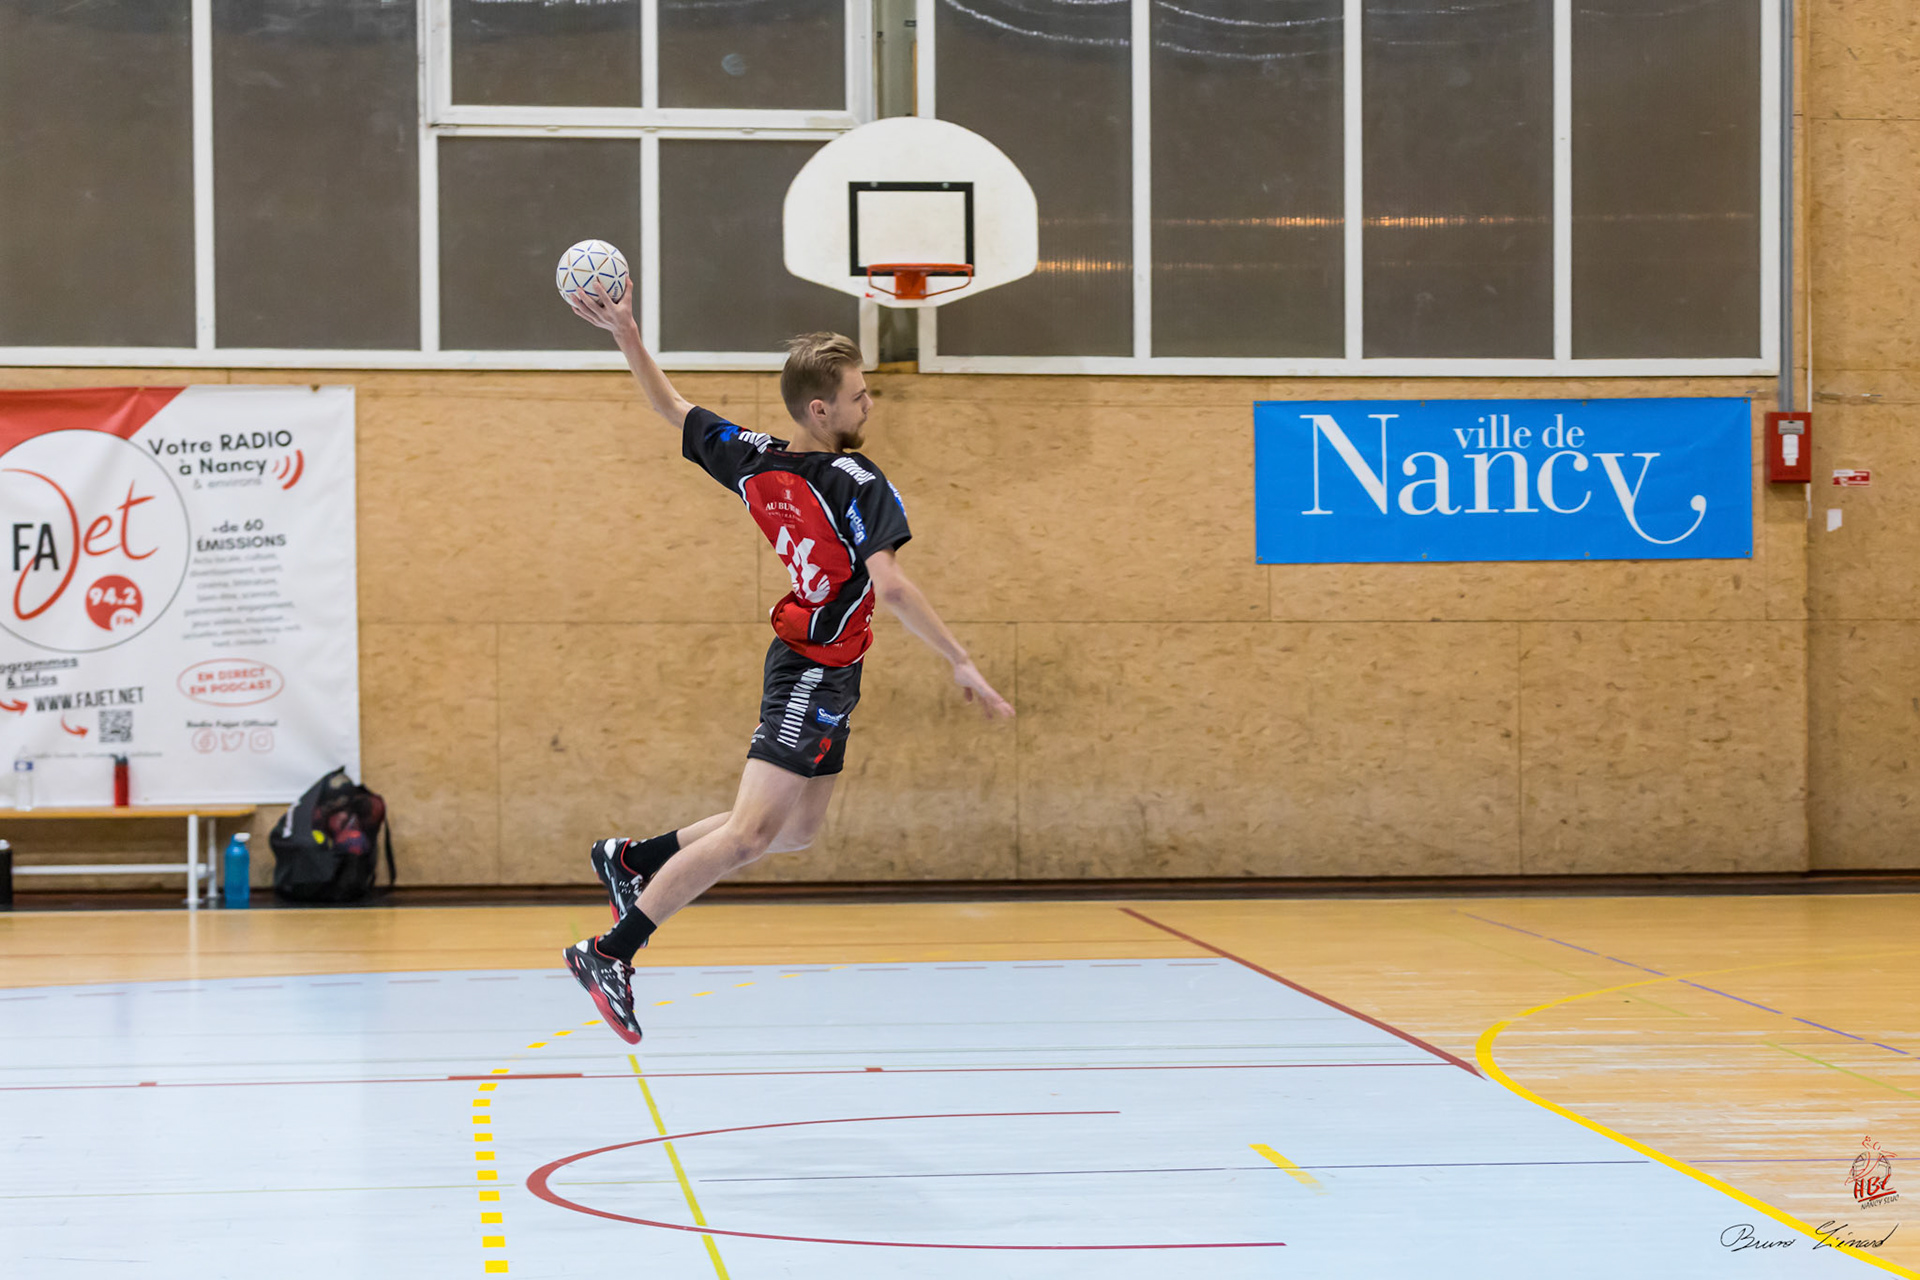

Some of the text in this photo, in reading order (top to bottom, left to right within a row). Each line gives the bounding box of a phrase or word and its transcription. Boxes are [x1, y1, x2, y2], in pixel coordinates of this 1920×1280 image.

[1452, 413, 1585, 449] ville de
[148, 430, 293, 456] Votre RADIO
[179, 457, 267, 476] à Nancy
[1299, 413, 1708, 545] Nancy
[196, 534, 287, 552] ÉMISSIONS
[89, 586, 137, 606] 94.2
[217, 667, 265, 680] DIRECT
[210, 679, 272, 694] PODCAST
[33, 687, 144, 712] WWW.FAJET.NET
